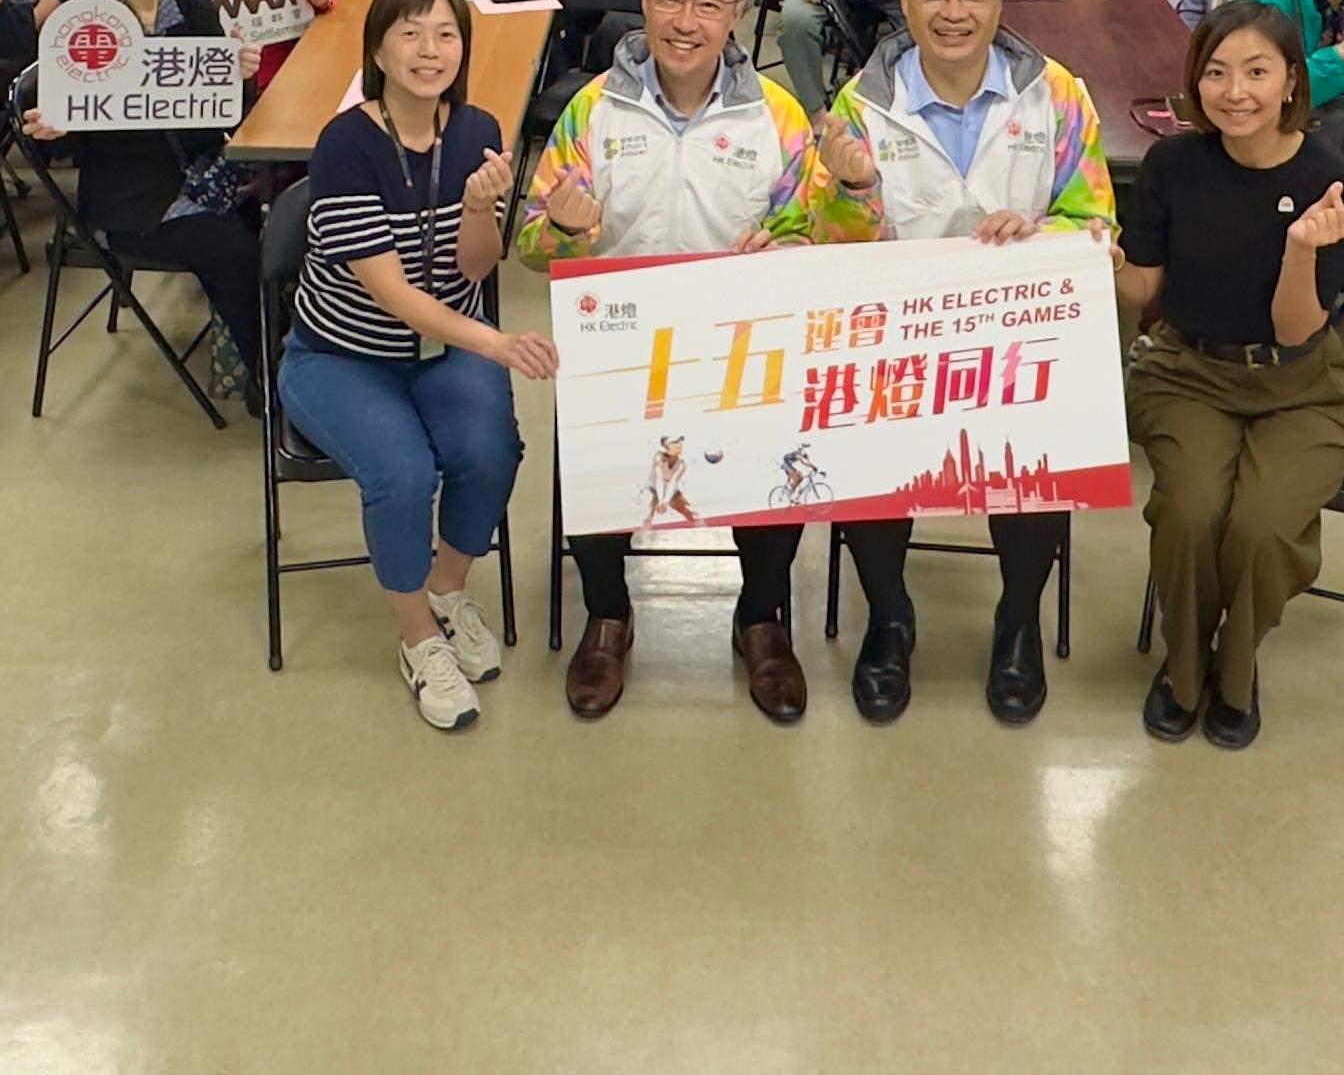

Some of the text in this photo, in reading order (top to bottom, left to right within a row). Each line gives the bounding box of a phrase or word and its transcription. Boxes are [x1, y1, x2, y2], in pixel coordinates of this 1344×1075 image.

[140, 46, 235, 88] 港燈
[67, 91, 234, 123] HK Electric
[901, 277, 1075, 316] HK ELECTRIC &
[899, 320, 944, 341] THE
[1001, 301, 1082, 327] GAMES
[798, 336, 1059, 432] 港燈同行
